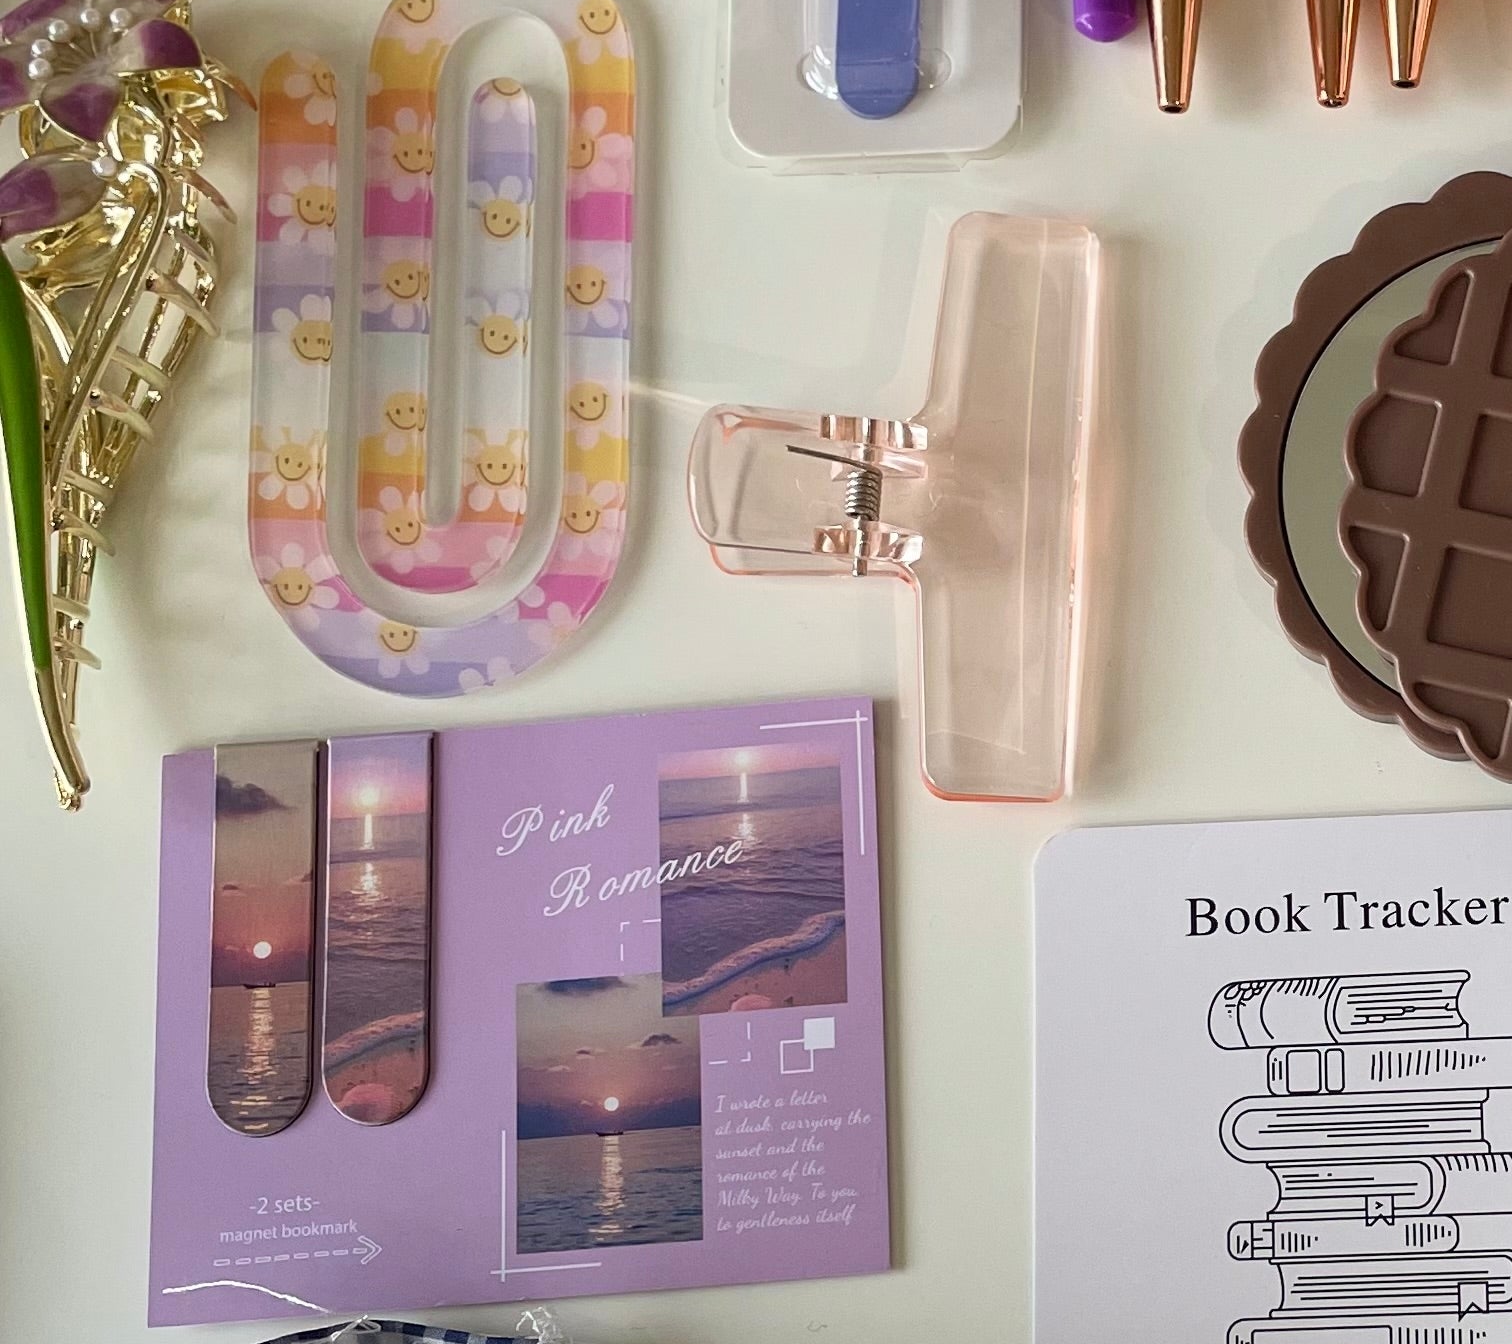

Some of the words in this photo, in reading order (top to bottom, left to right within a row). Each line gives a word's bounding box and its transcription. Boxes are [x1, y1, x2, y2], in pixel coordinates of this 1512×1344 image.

[496, 783, 615, 856] Pink
[543, 839, 744, 917] Romance
[1184, 892, 1312, 937] Book
[1323, 886, 1510, 931] Tracker
[714, 1094, 727, 1113] I
[730, 1094, 771, 1111] wrote
[774, 1098, 785, 1108] a
[790, 1089, 829, 1107] letter
[781, 1115, 843, 1132] carrying
[848, 1108, 872, 1126] the
[716, 1142, 762, 1159] sunset
[767, 1138, 798, 1155] and
[802, 1136, 825, 1153] the
[718, 1168, 778, 1183] romance
[782, 1160, 799, 1182] of
[802, 1159, 826, 1177] the
[249, 1196, 269, 1215] -2
[274, 1194, 321, 1214] sets-
[718, 1189, 760, 1209] Milky
[811, 1182, 826, 1200] To
[220, 1225, 278, 1245] magnet
[281, 1218, 358, 1239] bookmark
[717, 1216, 732, 1232] to
[736, 1210, 810, 1234] gentleness
[816, 1203, 857, 1226] itself
